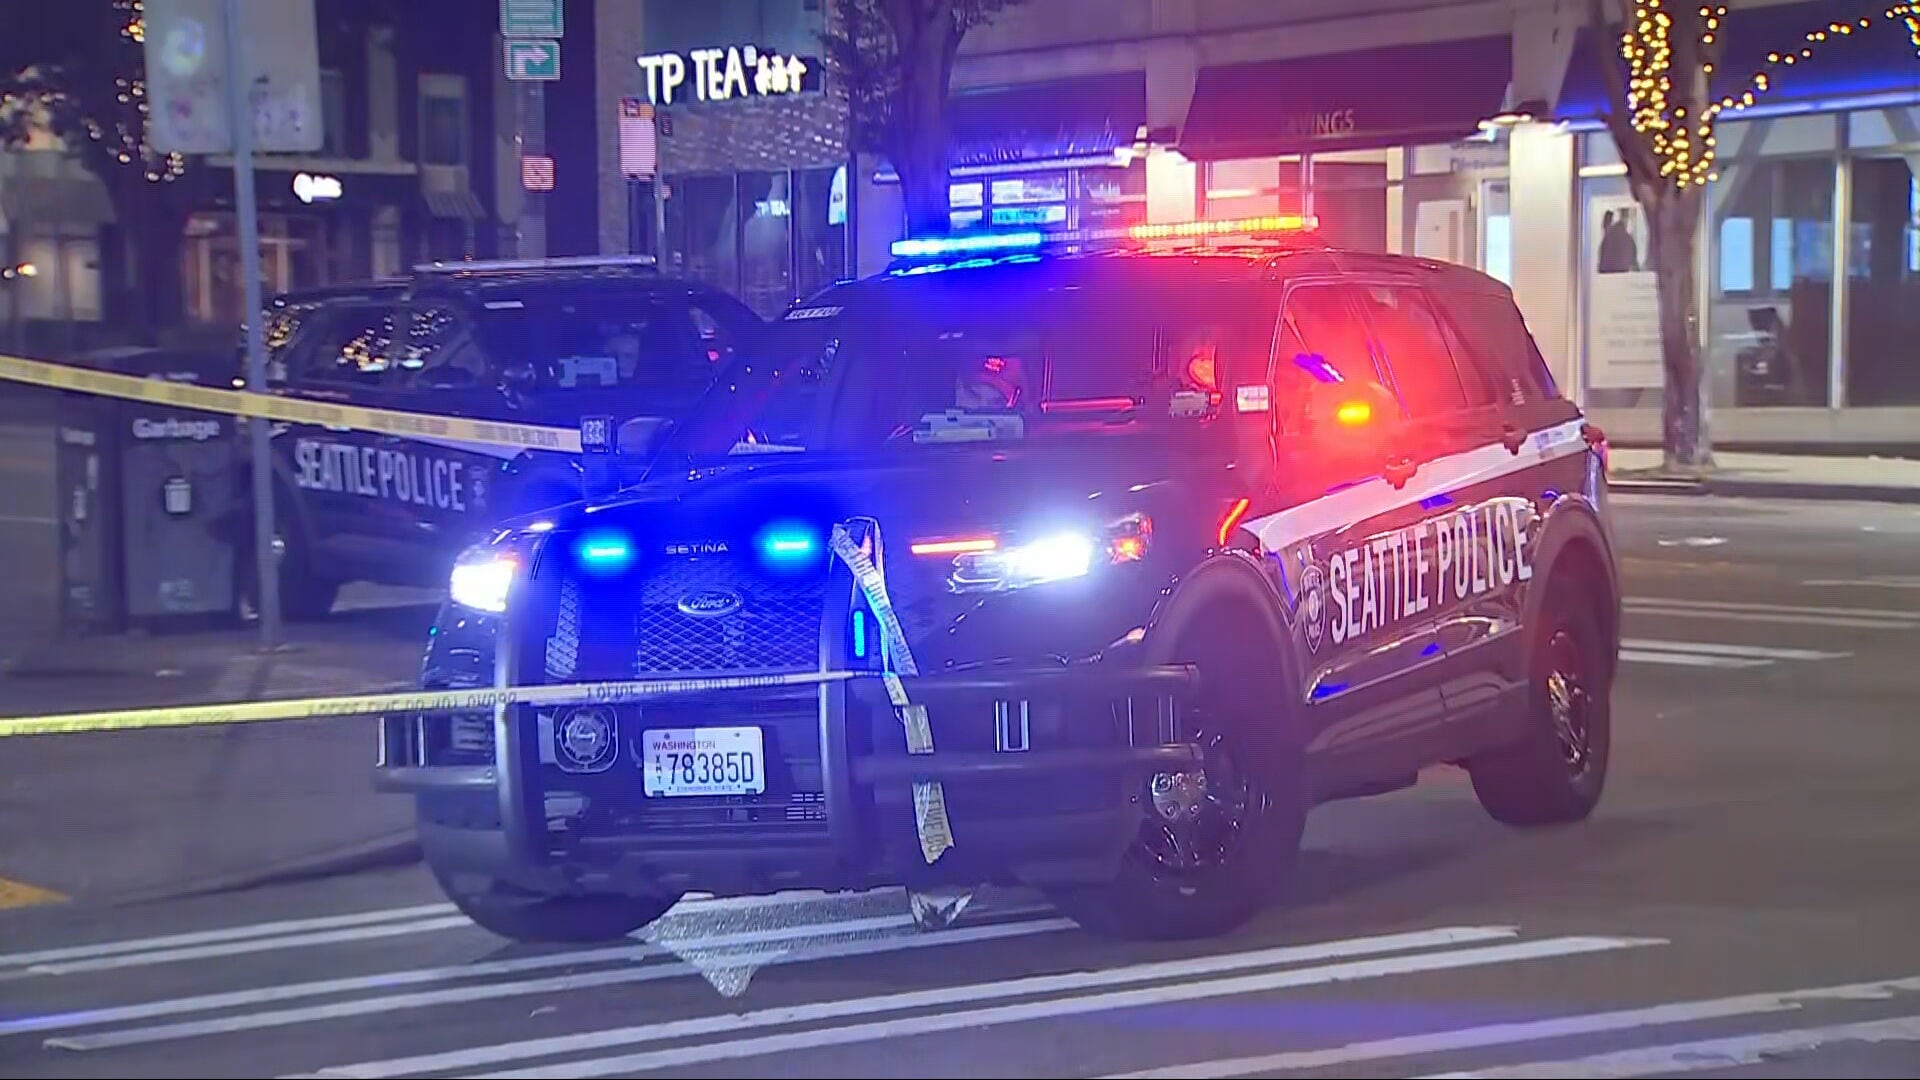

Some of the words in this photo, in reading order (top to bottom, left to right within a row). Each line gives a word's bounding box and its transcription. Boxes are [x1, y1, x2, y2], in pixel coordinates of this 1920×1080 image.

[637, 53, 686, 106] TP
[691, 46, 748, 101] TEA
[294, 438, 378, 496] SEATTLE
[377, 450, 466, 512] POLICE
[665, 543, 728, 555] SETINA
[1330, 523, 1430, 644] SEATTLE
[1436, 501, 1533, 606] POLICE
[652, 740, 716, 751] WASHINGTON
[667, 752, 754, 785] 78385D
